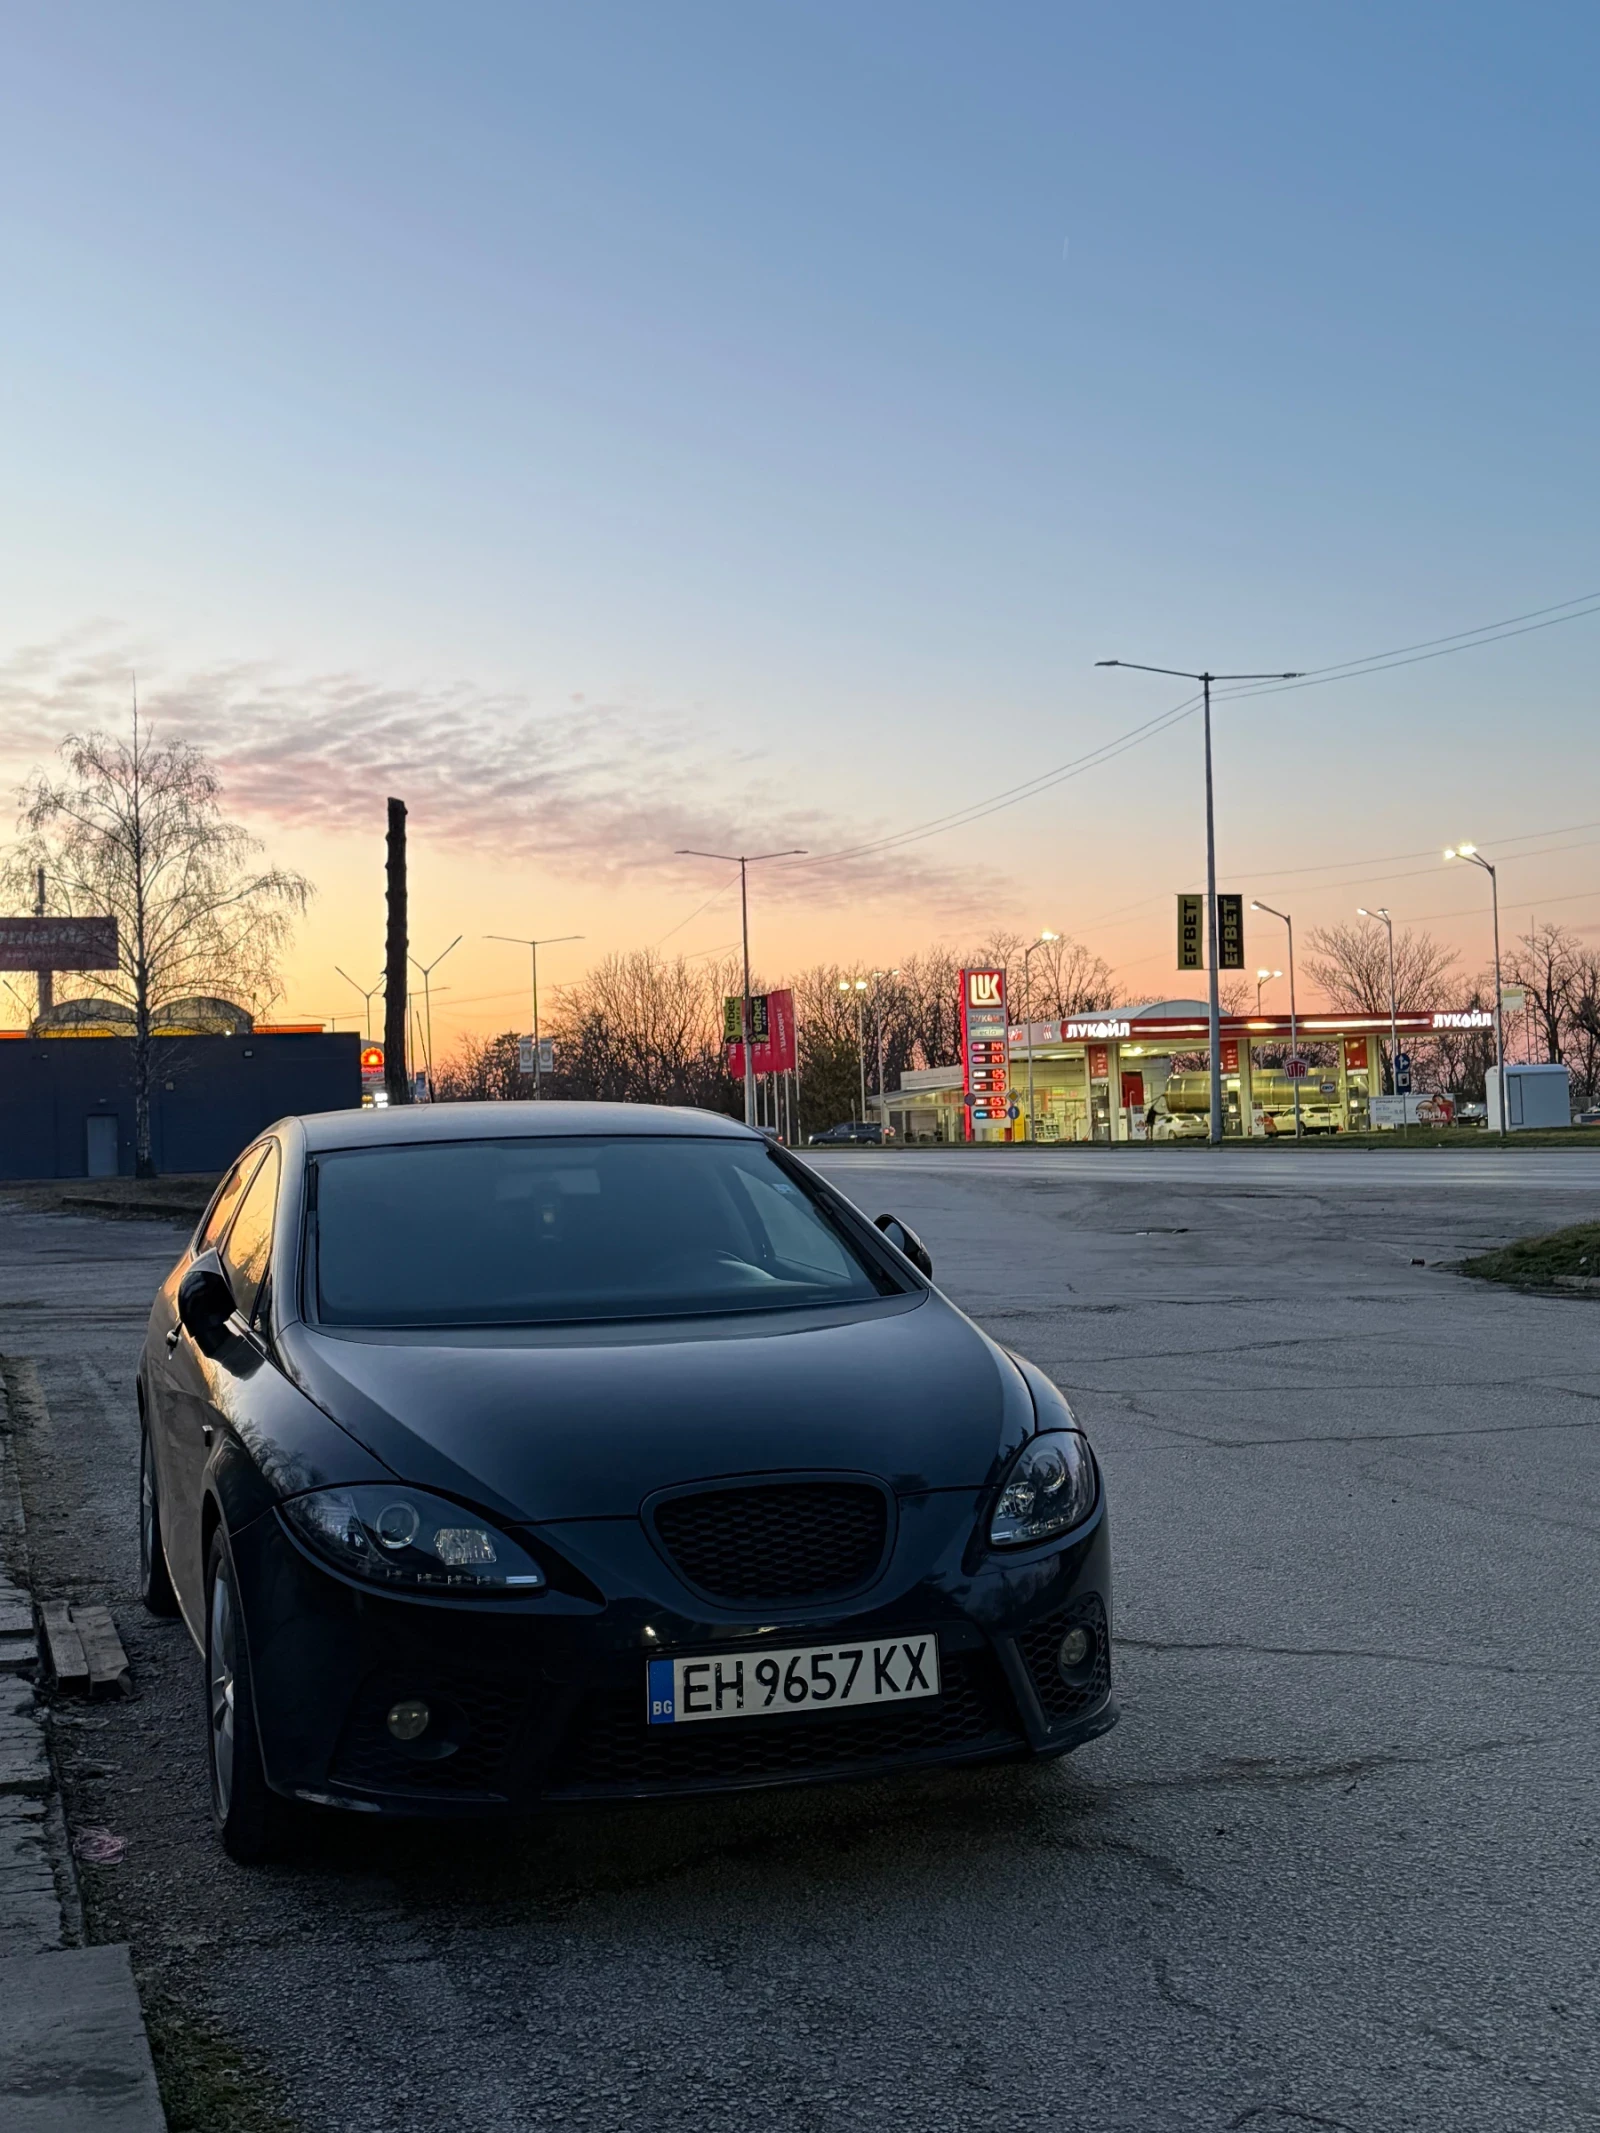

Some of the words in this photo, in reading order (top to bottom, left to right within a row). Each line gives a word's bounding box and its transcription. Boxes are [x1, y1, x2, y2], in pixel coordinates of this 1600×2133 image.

[1184, 899, 1197, 965] EFBET
[1223, 898, 1238, 965] EFBET
[727, 999, 735, 1032] efbet
[753, 998, 762, 1033] efbet
[1065, 1018, 1130, 1038] ЛУКОЙЛ
[1432, 1009, 1492, 1028] ЛУКОЙЛ
[682, 1660, 744, 1713] EH
[755, 1649, 864, 1707] 9657
[873, 1641, 930, 1695] KX
[652, 1700, 673, 1716] BG
